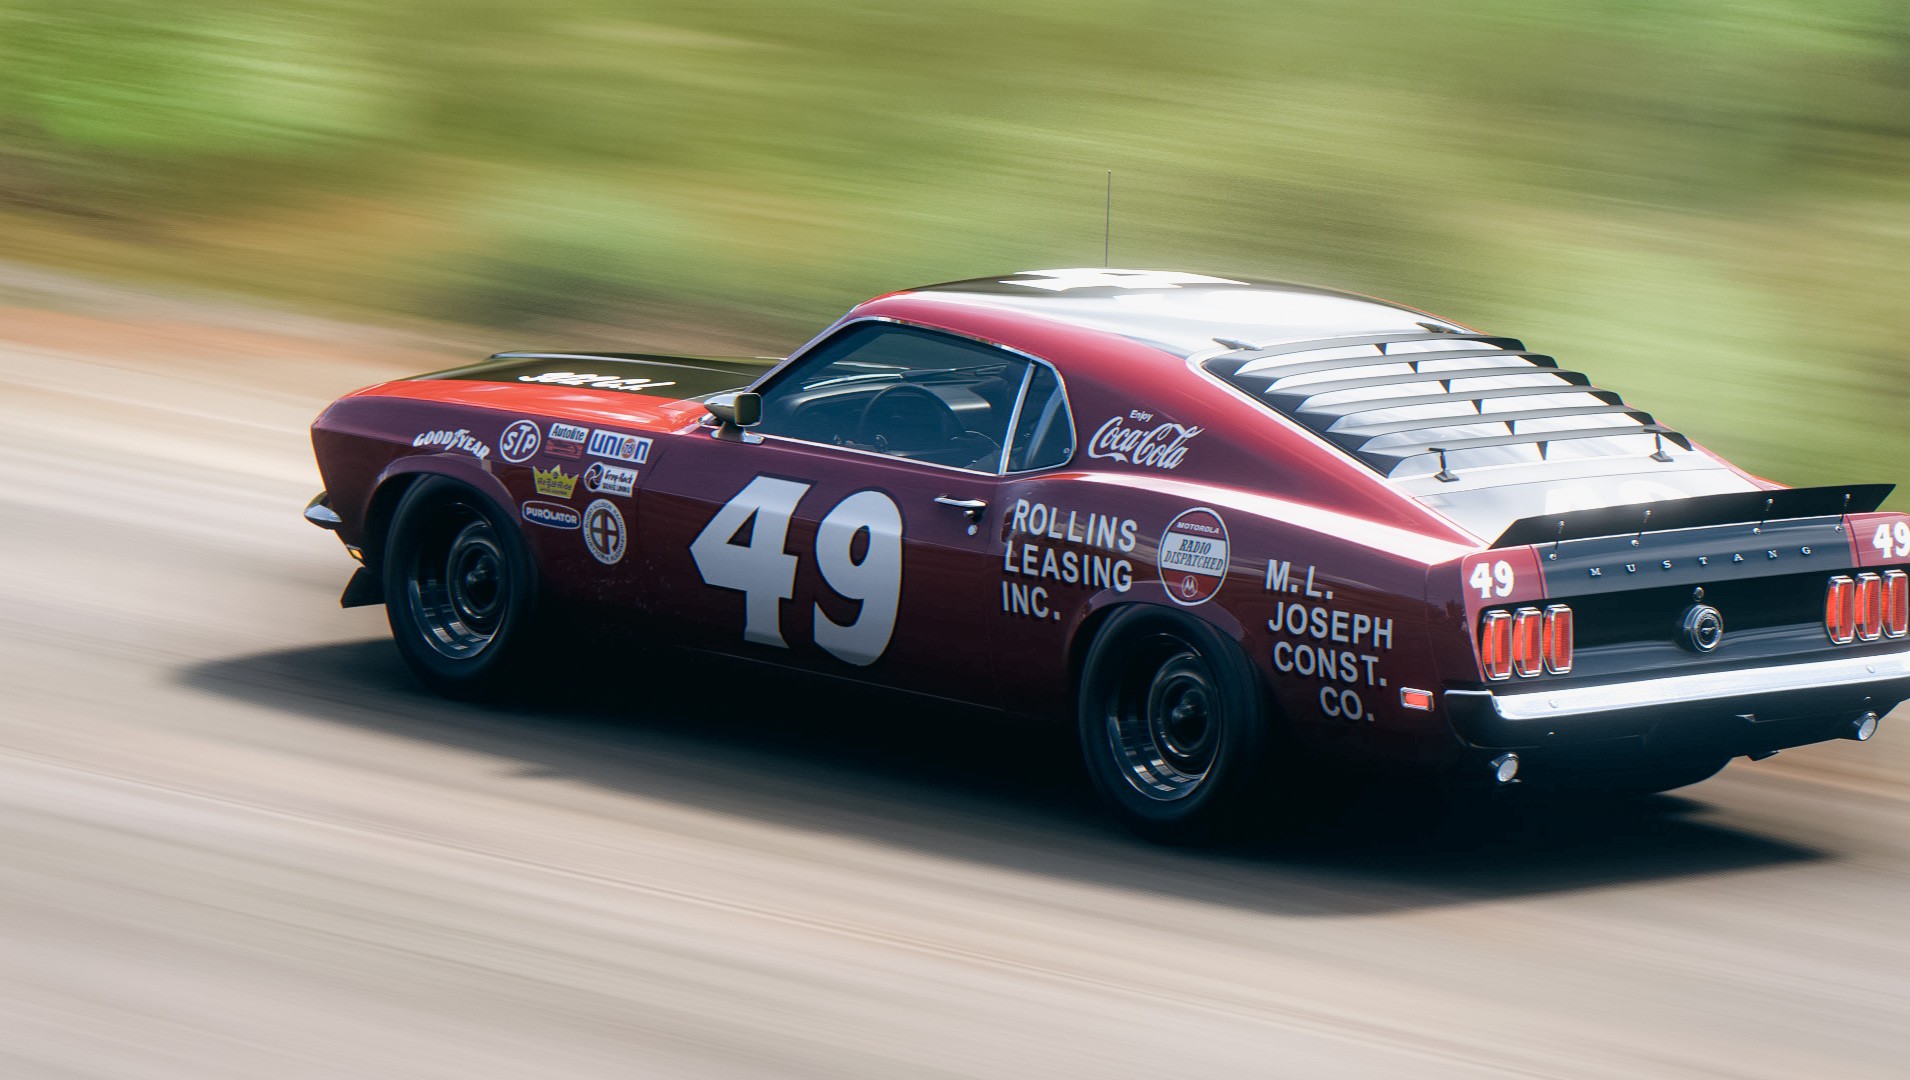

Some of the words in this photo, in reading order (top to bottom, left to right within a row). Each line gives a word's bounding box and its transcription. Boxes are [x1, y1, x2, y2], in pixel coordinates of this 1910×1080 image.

[552, 425, 585, 441] Autolite
[1129, 409, 1154, 422] Enjoy
[412, 428, 491, 460] GOODYEAR
[503, 425, 536, 455] STP
[1087, 416, 1205, 469] Coca-Cola
[526, 506, 578, 524] PUROLATOR
[1011, 498, 1138, 552] ROLLINS
[1177, 521, 1219, 534] MOTOROLA
[1179, 539, 1211, 555] RADIO
[1872, 521, 1910, 559] 49
[689, 472, 904, 667] 49
[1004, 540, 1133, 593] LEASING
[1163, 550, 1224, 570] DISPATCHED
[1589, 545, 1812, 577] MUSTANG
[1469, 559, 1514, 599] 49
[1002, 580, 1060, 621] INC.
[1268, 601, 1393, 650] JOSEPH
[1273, 641, 1388, 687] CONST.
[1319, 686, 1375, 722] CO.
